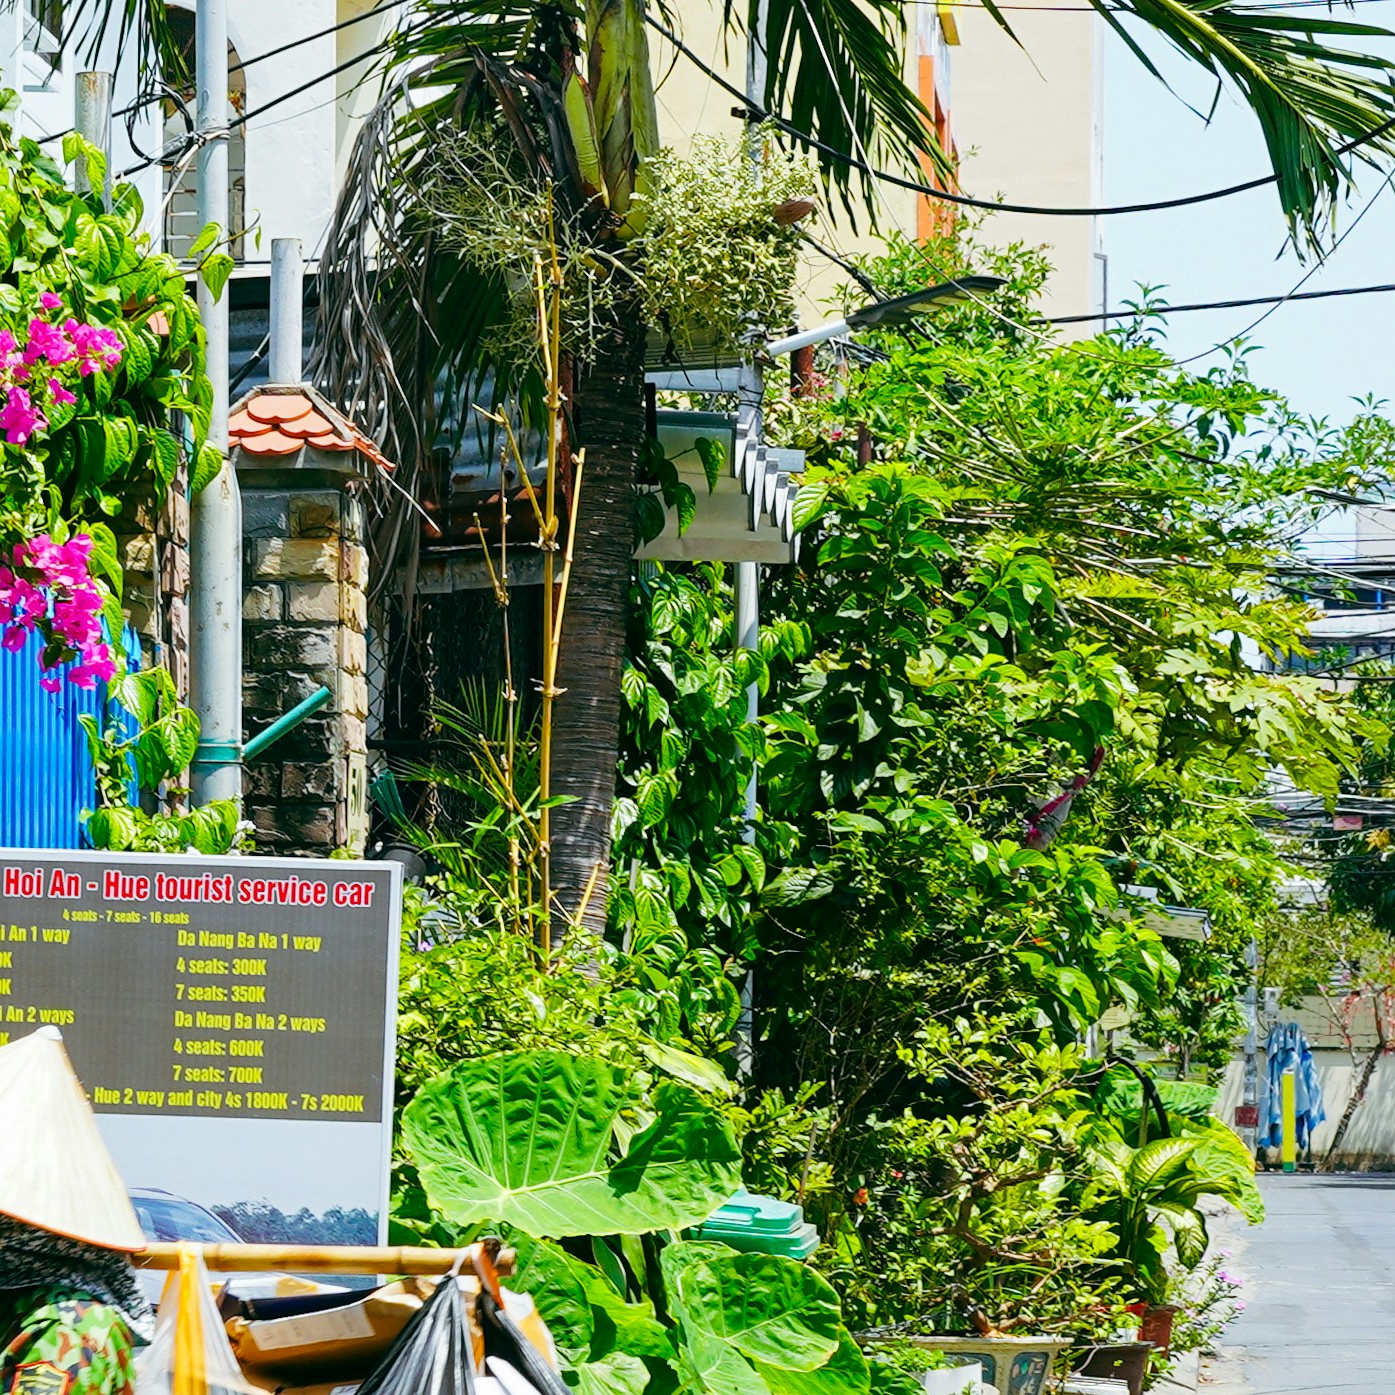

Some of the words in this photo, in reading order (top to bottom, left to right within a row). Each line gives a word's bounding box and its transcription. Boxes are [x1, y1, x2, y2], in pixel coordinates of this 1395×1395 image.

[4, 868, 43, 896] Hoi
[50, 869, 80, 897] An
[104, 871, 148, 900] Hue
[157, 873, 232, 901] tourist
[238, 876, 326, 904] service
[334, 882, 373, 906] car
[63, 909, 69, 920] 4
[71, 910, 98, 922] seats
[106, 910, 112, 922] 7
[114, 911, 141, 923] seats
[150, 911, 161, 923] 16
[163, 912, 189, 924] seats
[9, 925, 27, 942] An
[31, 926, 37, 942] 1
[43, 928, 70, 945] way
[178, 930, 195, 946] Da
[199, 931, 233, 949] Nang
[237, 932, 255, 948] Ba
[259, 932, 277, 949] Na
[282, 933, 288, 949] 1
[293, 935, 321, 952] way
[176, 957, 186, 973] 4
[189, 958, 229, 974] seats:
[232, 959, 267, 976] 300K
[175, 983, 185, 1000] 7
[188, 984, 228, 1001] seats:
[231, 985, 266, 1003] 350K
[6, 1006, 23, 1023] An
[27, 1007, 36, 1022] 2
[39, 1008, 75, 1025] ways
[174, 1010, 193, 1027] Da
[196, 1011, 231, 1031] Nang
[234, 1012, 252, 1030] Ba
[256, 1013, 275, 1030] Na
[278, 1014, 288, 1031] 2
[290, 1015, 326, 1033] ways
[173, 1038, 183, 1054] 4
[186, 1038, 226, 1056] seats:
[229, 1040, 265, 1057] 600K
[173, 1065, 182, 1081] 7
[185, 1065, 225, 1083] seats:
[228, 1067, 263, 1084] 700K
[94, 1087, 120, 1104] Hue
[124, 1088, 133, 1104] 2
[137, 1089, 164, 1108] way
[168, 1089, 193, 1107] and
[197, 1091, 222, 1109] city
[225, 1091, 242, 1108] 4s
[246, 1092, 288, 1110] 1800K
[301, 1094, 318, 1111] 7s
[320, 1094, 364, 1112] 2000K
